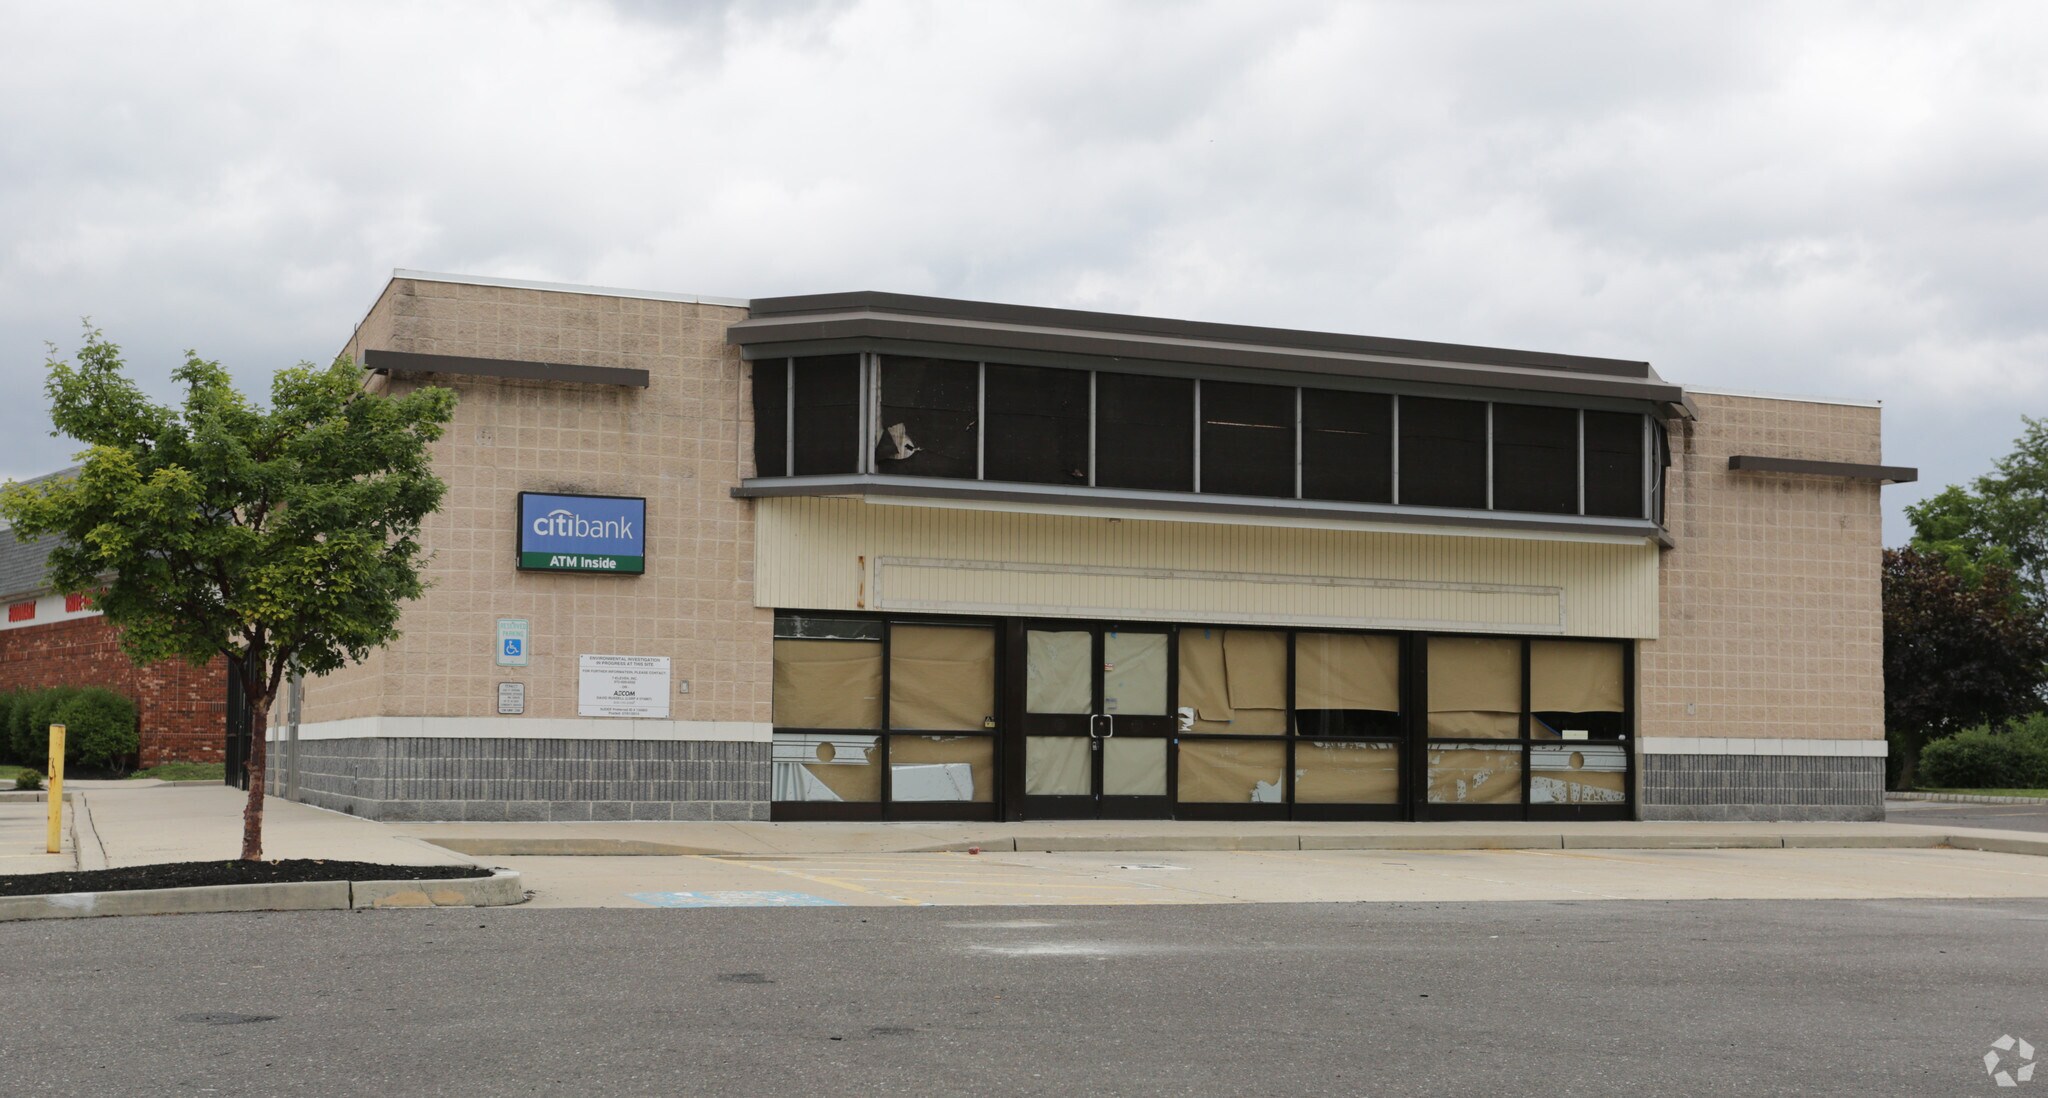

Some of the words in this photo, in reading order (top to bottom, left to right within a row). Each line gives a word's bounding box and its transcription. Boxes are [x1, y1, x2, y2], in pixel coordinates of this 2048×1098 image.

[533, 509, 633, 540] citibank
[549, 556, 577, 567] ATM
[580, 556, 617, 569] Inside
